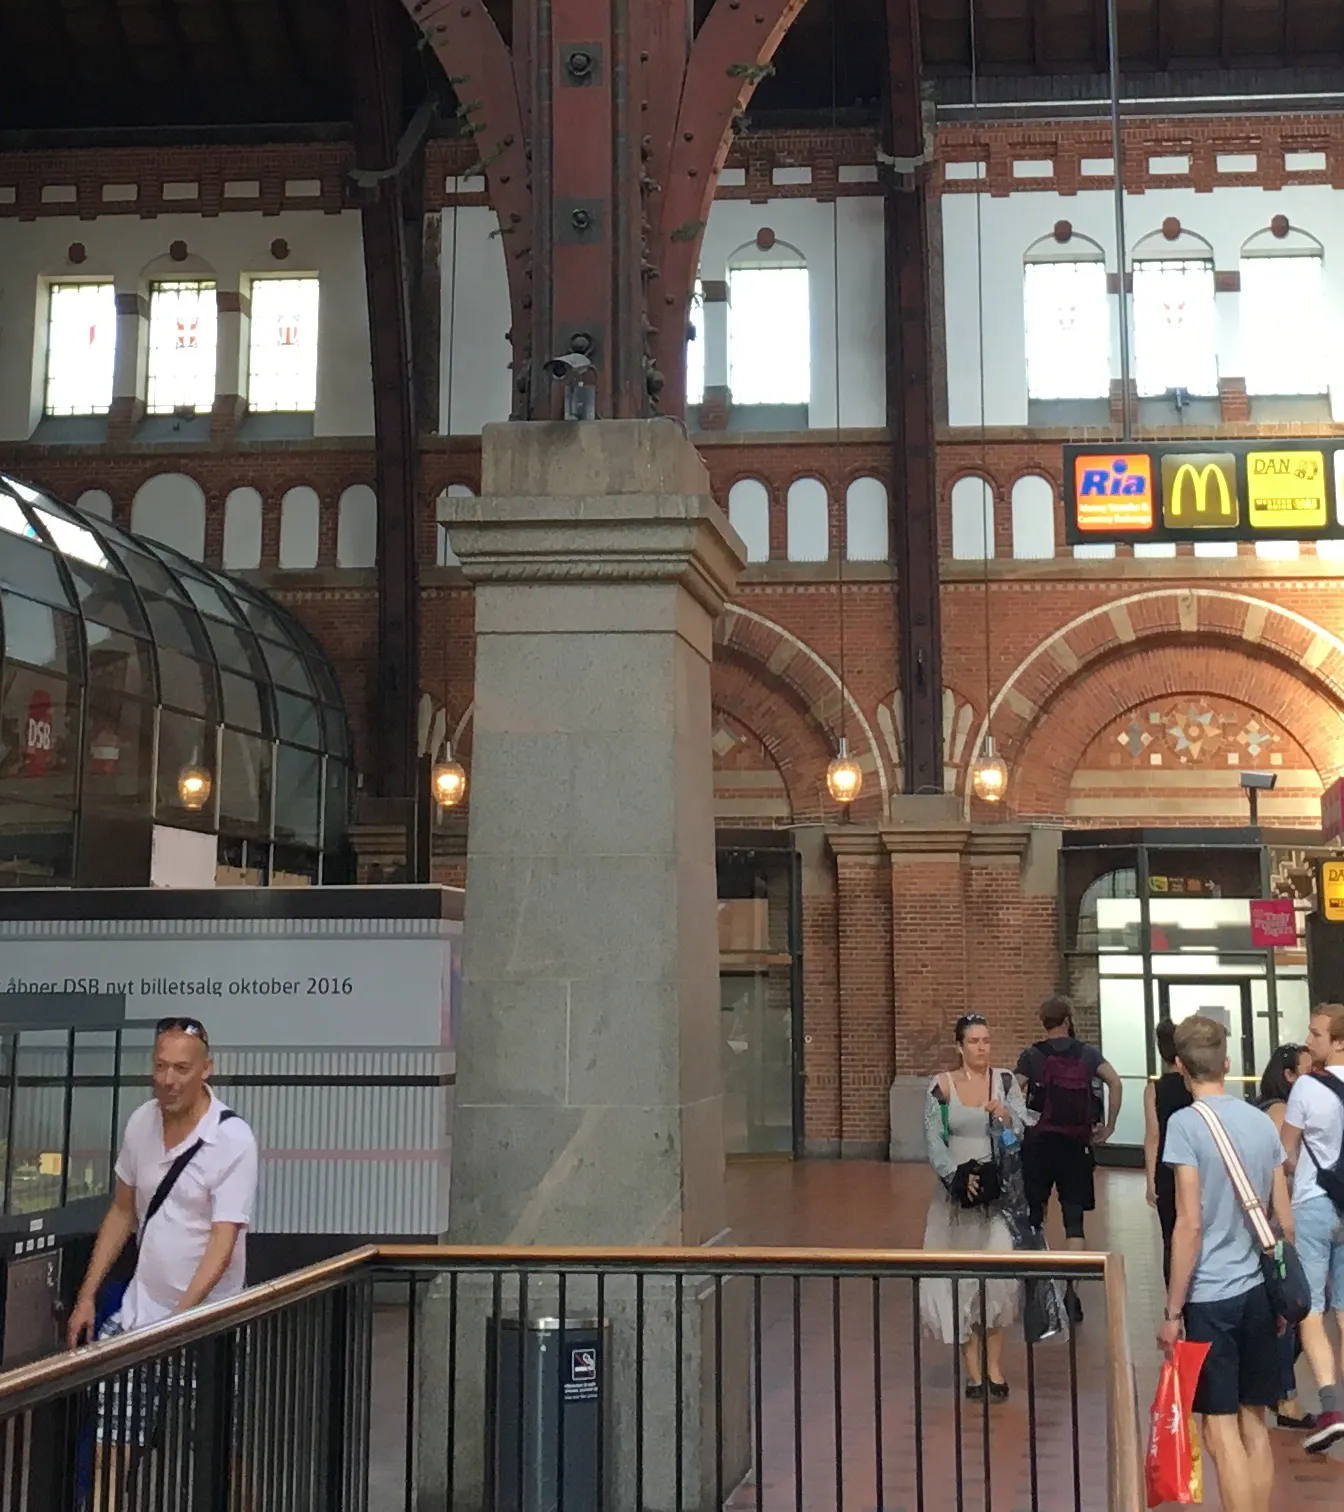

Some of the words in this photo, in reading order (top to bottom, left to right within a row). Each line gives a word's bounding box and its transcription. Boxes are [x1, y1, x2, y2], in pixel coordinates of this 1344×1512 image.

[1080, 458, 1147, 496] Ria
[1253, 458, 1291, 474] DAN
[28, 718, 51, 750] DSB
[6, 977, 58, 994] åbner
[64, 978, 100, 994] DSB
[106, 980, 134, 995] nyt
[141, 977, 223, 997] billetsalg
[228, 977, 301, 996] oktober
[306, 977, 353, 996] 2016
